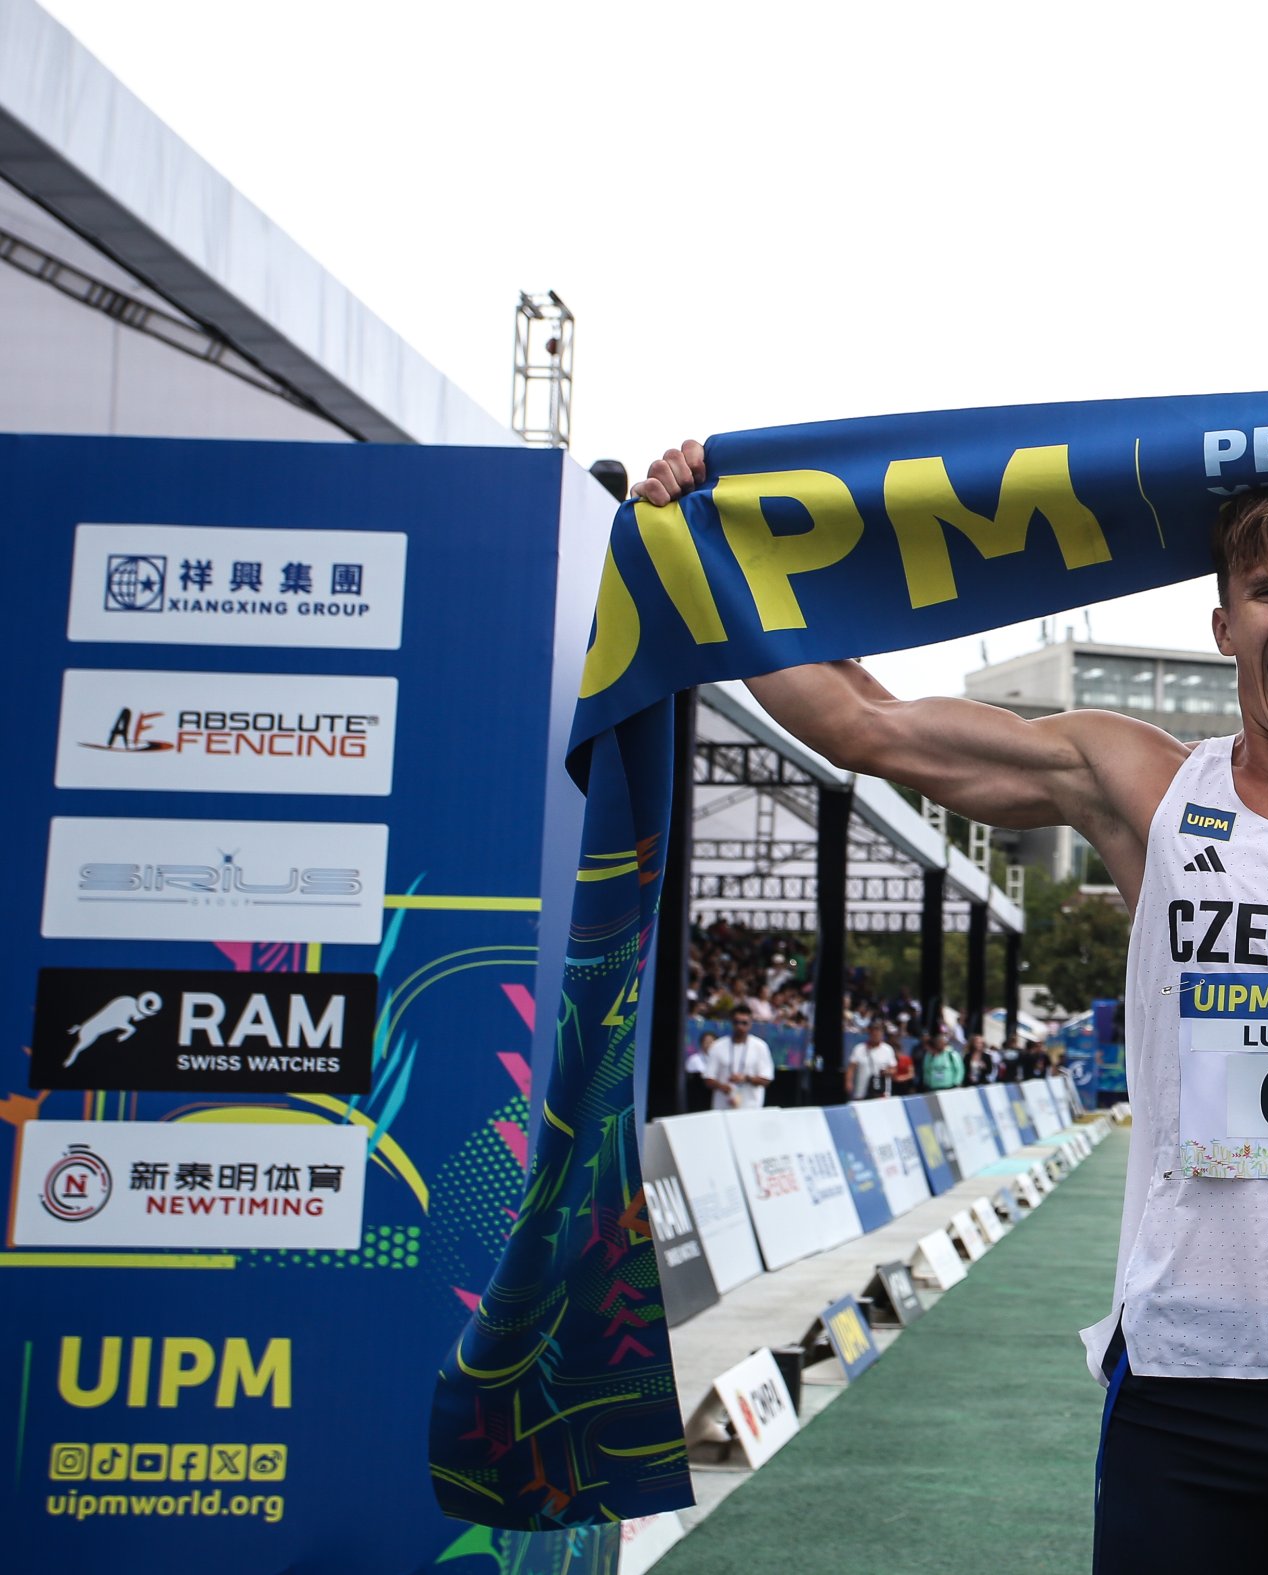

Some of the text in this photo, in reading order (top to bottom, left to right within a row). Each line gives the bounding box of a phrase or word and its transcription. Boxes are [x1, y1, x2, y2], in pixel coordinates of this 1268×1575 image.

[179, 558, 364, 596] 祥興集團
[167, 598, 371, 617] XIANGXING GROUP
[176, 732, 366, 758] FENCING
[1186, 812, 1229, 832] UIPM
[178, 991, 346, 1049] RAM
[176, 1054, 341, 1073] SWISS WATCHES
[129, 1161, 345, 1194] 新泰明体育
[145, 1196, 324, 1217] NEWTIMING
[58, 1336, 292, 1408] UIPM
[46, 1489, 285, 1523] uipmworld.org
